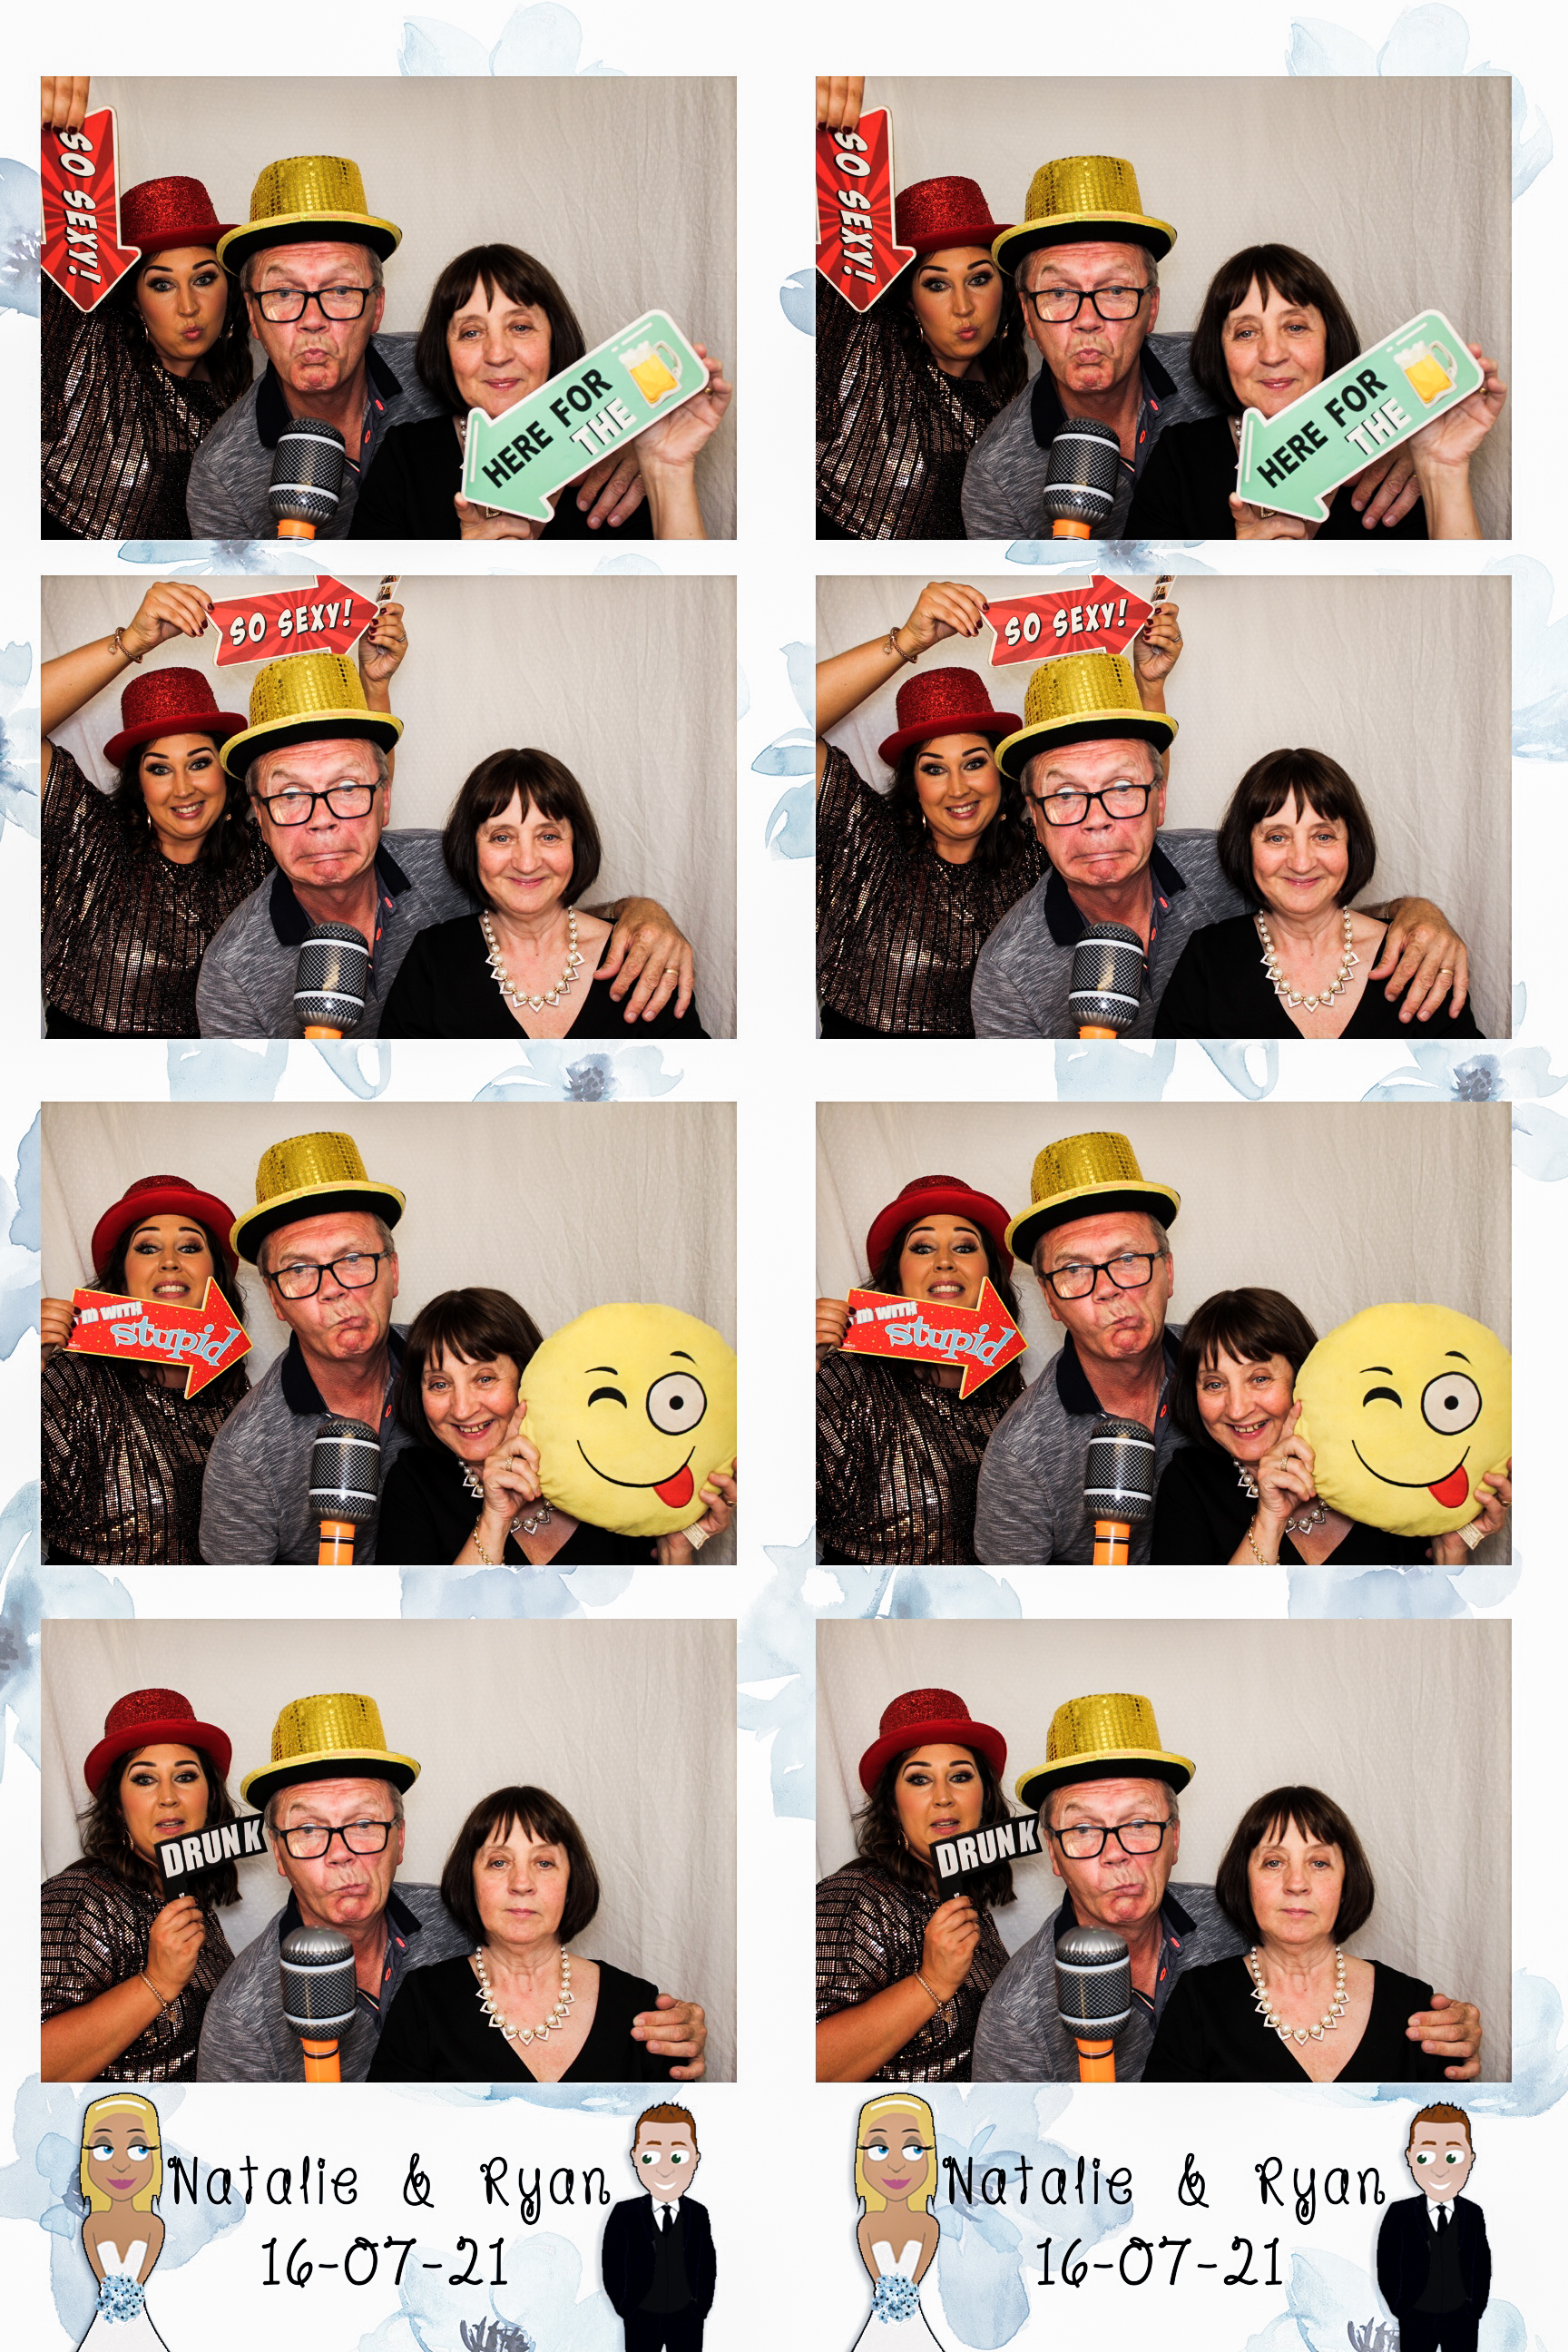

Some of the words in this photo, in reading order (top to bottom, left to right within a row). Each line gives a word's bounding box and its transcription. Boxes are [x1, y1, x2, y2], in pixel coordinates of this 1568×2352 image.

[58, 131, 96, 177] SO
[833, 131, 871, 177] SO
[62, 189, 102, 284] SEXY!
[837, 189, 877, 284] SEXY!
[482, 420, 554, 488] HERE
[549, 368, 612, 427] FOR
[569, 397, 637, 456] THE
[1257, 420, 1328, 488] HERE
[1324, 368, 1387, 427] FOR
[1344, 397, 1412, 456] THE
[230, 612, 267, 647] SO
[278, 598, 353, 638] SEXY!
[1004, 612, 1042, 647] SO
[1053, 598, 1128, 638] SEXY!
[100, 1300, 142, 1321] WITH
[875, 1300, 917, 1321] WITH
[110, 1316, 241, 1367] stupid
[885, 1316, 1016, 1367] stupid
[161, 1818, 262, 1878] DRUNK
[936, 1818, 1037, 1878] DRUNK
